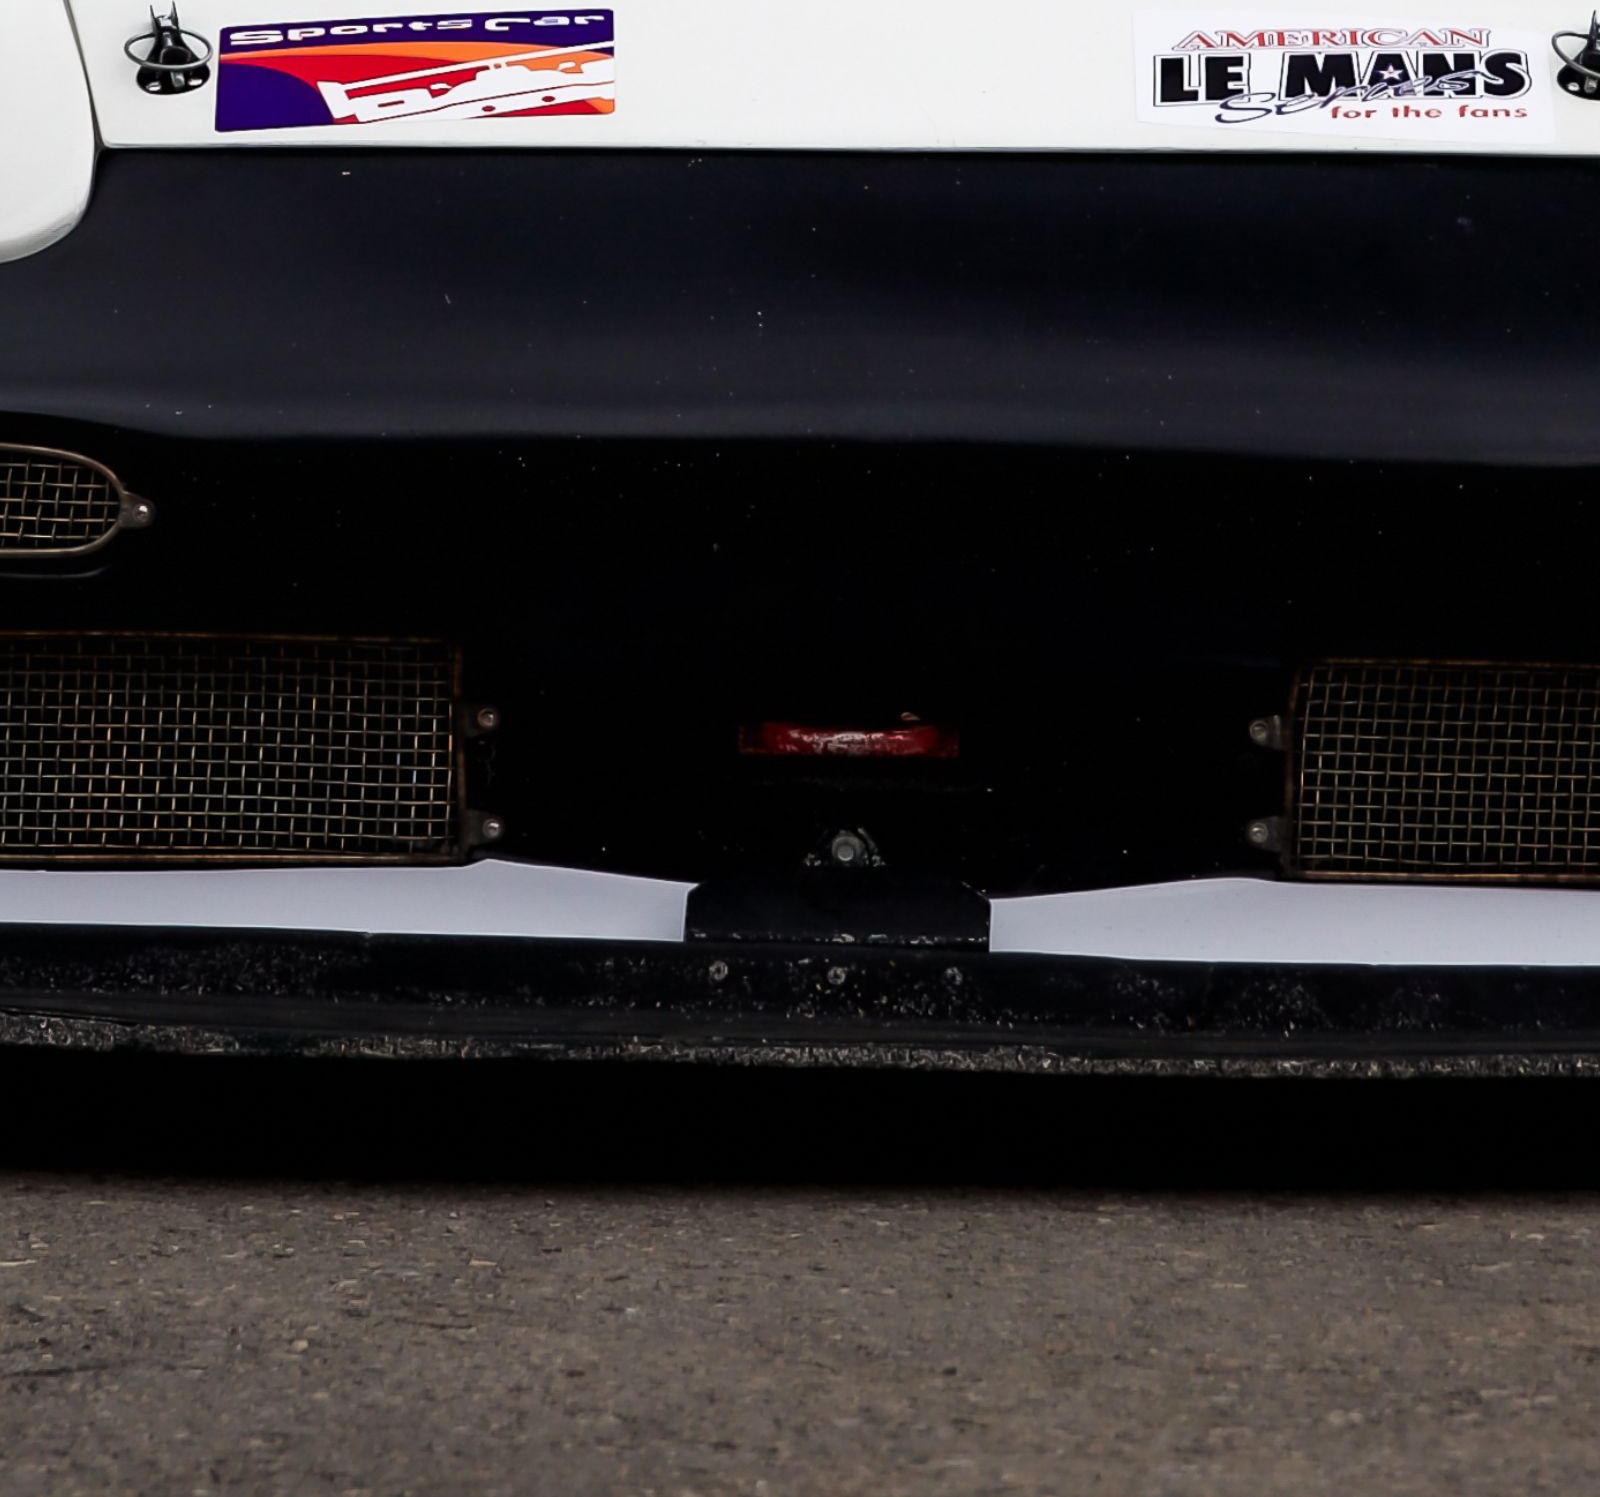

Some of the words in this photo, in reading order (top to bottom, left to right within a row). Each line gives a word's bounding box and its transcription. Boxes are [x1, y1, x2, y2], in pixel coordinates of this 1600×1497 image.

[229, 18, 473, 46] Sports
[483, 15, 606, 32] Car
[1171, 27, 1492, 51] AMERICAN
[1153, 52, 1252, 107] LE
[1279, 50, 1532, 102] MANS
[1214, 68, 1503, 124] Series
[1331, 105, 1375, 120] for
[1392, 104, 1443, 119] the
[1457, 104, 1528, 119] fans
